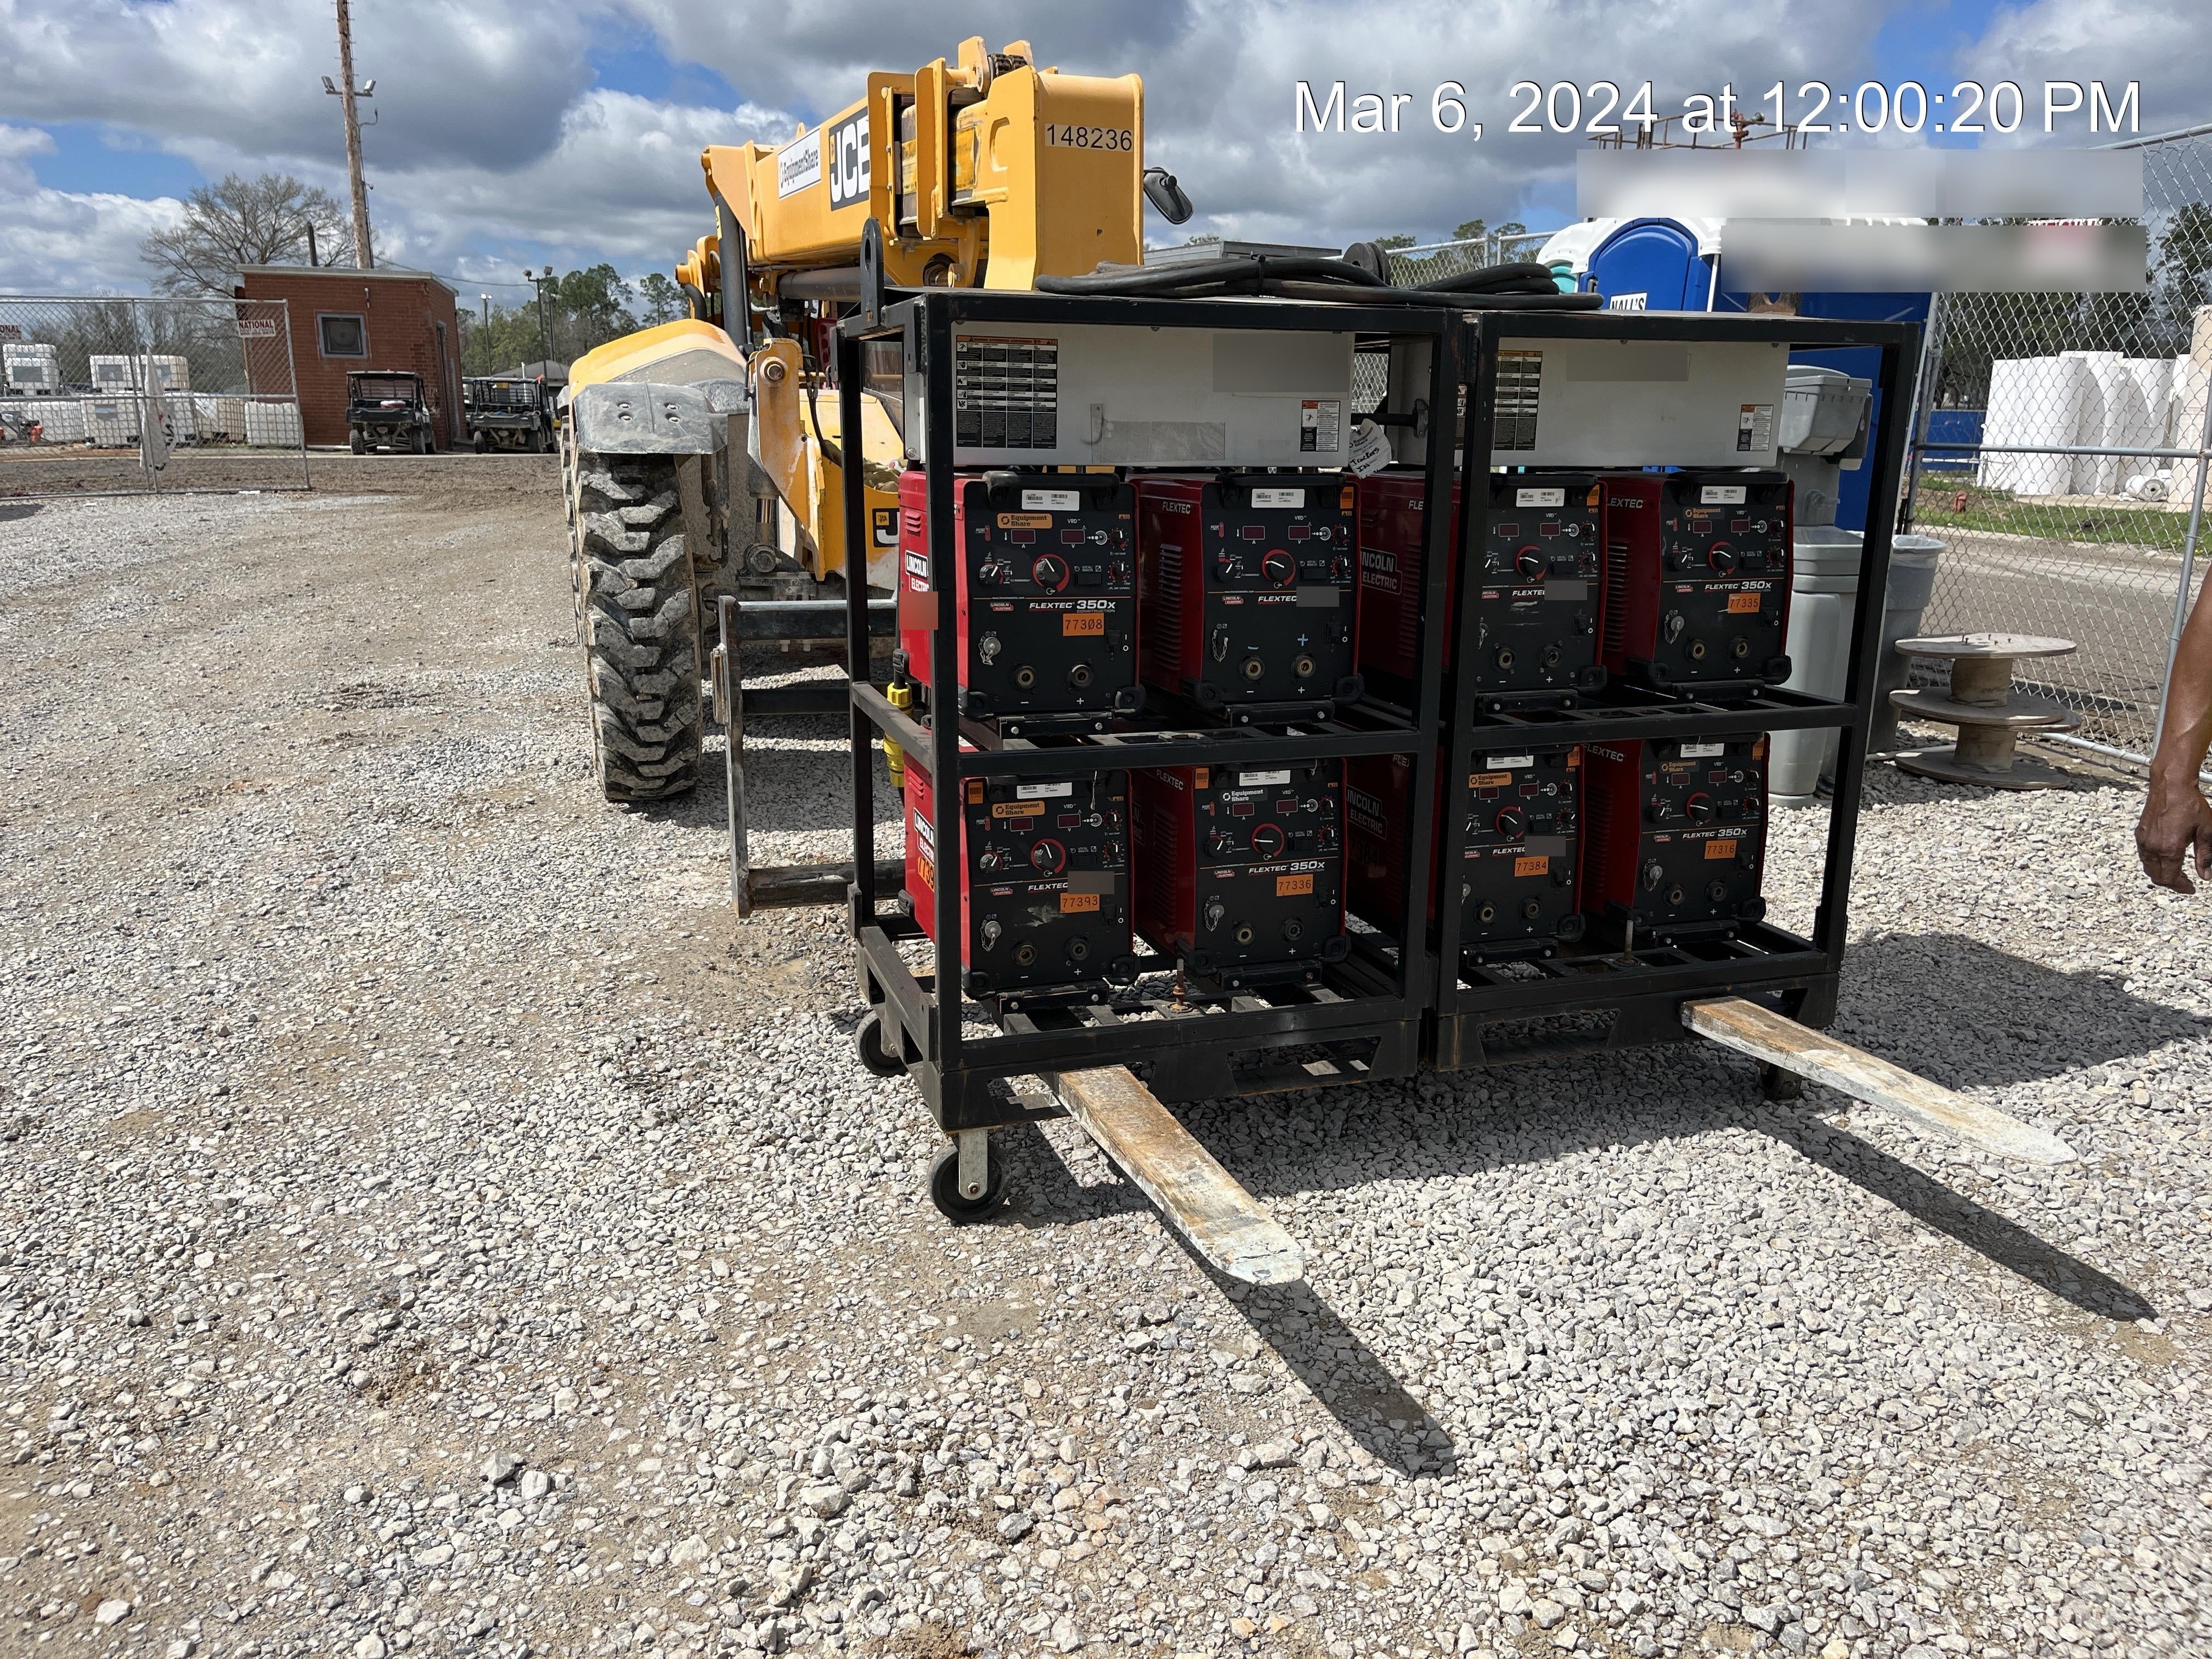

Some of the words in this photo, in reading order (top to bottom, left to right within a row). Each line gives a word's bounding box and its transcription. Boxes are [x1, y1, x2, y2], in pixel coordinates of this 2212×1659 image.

[1047, 124, 1132, 151] 148236
[239, 320, 274, 329] NATIONAL
[1162, 501, 1190, 515] FLEXTEC
[906, 555, 927, 578] LINCOLN
[1361, 551, 1394, 572] NCOLN
[1362, 571, 1397, 590] ELECTRIC
[1730, 599, 1758, 608] 77335
[1156, 769, 1184, 790] FLEXTEC
[1347, 788, 1380, 817] INCOLN
[1350, 808, 1383, 834] ELECTRIC
[915, 812, 934, 847] LINCOLN
[919, 837, 935, 862] ELECTR
[1707, 844, 1735, 854] 77316
[1249, 865, 1288, 873] FLEXTEC
[1516, 861, 1546, 871] 77384
[1028, 883, 1068, 891] FLEXTEC
[1279, 879, 1311, 891] 77336
[1062, 896, 1098, 907] 77393
